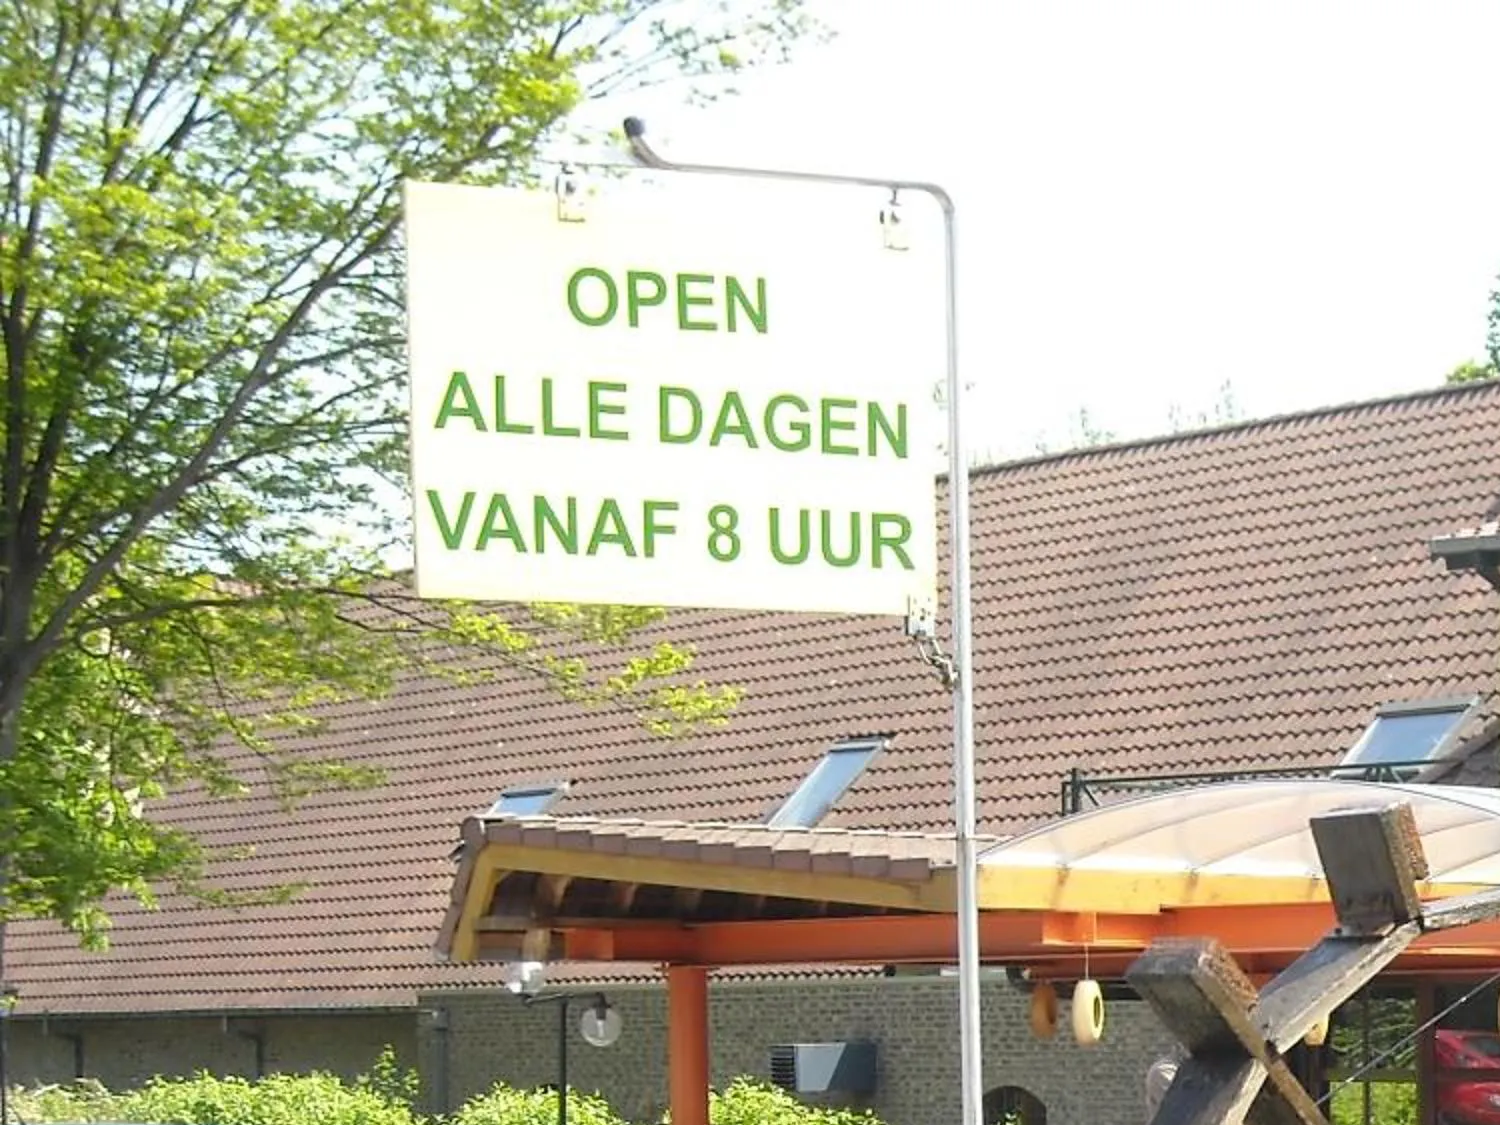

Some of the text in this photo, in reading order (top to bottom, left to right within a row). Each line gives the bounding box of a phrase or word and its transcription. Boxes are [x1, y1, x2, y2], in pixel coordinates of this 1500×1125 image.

[566, 266, 769, 334] OPEN
[433, 371, 908, 459] ALLE DAGEN
[425, 488, 915, 570] VANAF 8 UUR
